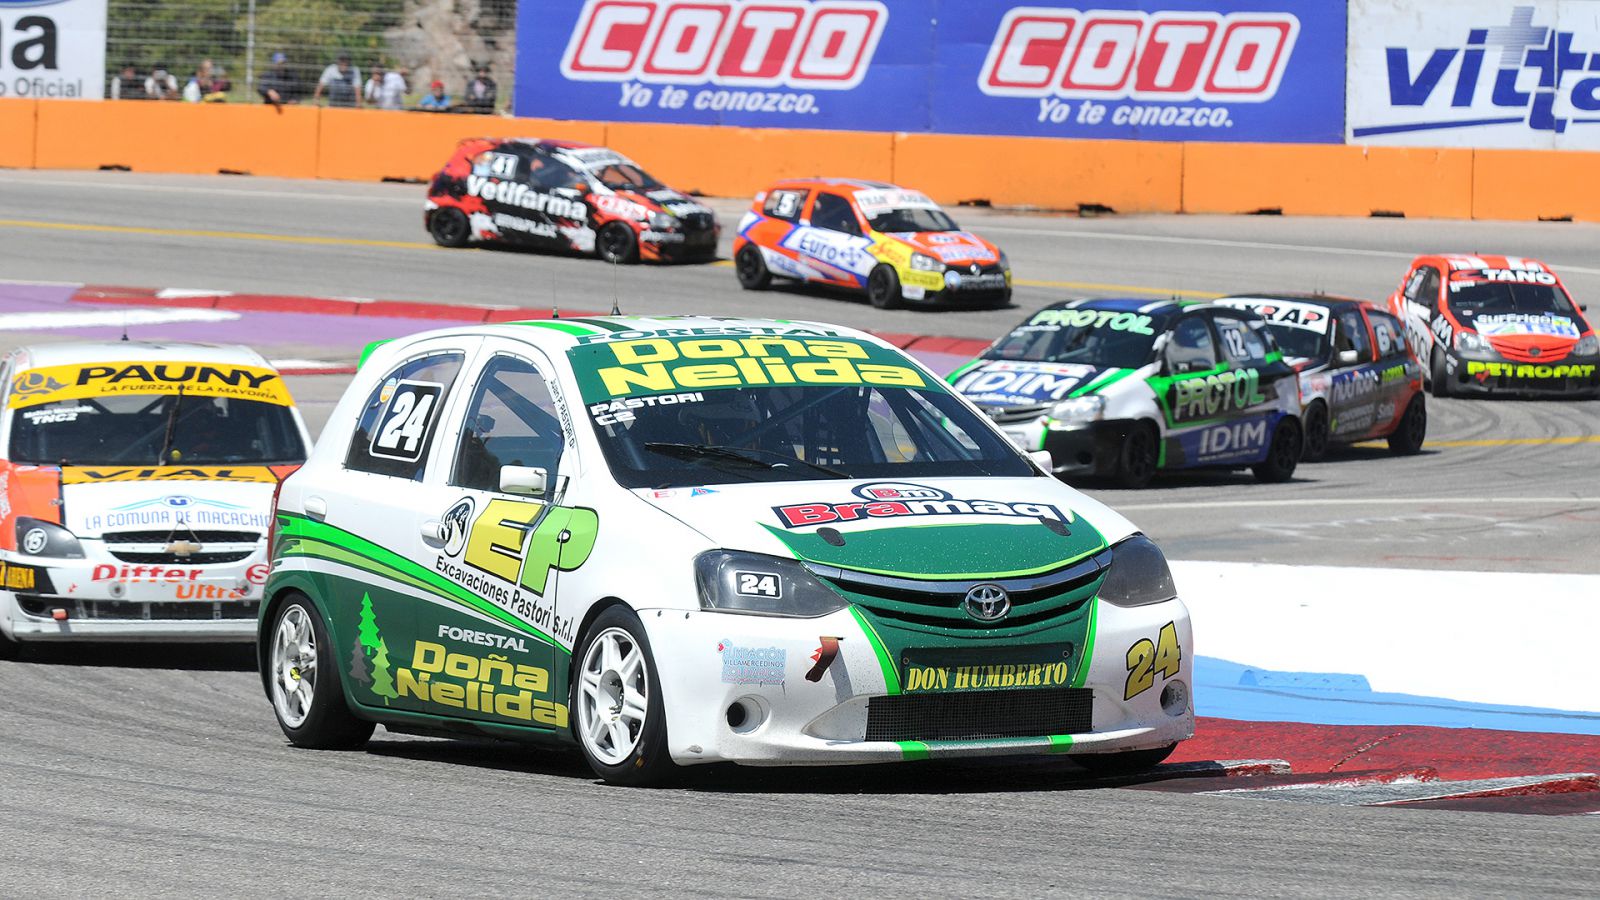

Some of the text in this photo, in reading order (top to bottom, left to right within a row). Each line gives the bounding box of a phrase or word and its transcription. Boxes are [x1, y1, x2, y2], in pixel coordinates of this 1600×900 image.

[570, 1, 879, 82] COTO
[987, 14, 1294, 94] COTO
[15, 77, 82, 97] Oficial
[618, 82, 819, 114] Yo te conozco.
[1038, 99, 1234, 128] Yo te conozco.
[492, 155, 516, 175] 41
[467, 174, 587, 220] Vetifarma
[800, 237, 837, 260] Euro
[1482, 269, 1556, 284] TANO
[577, 327, 854, 345] FORESTAL
[608, 335, 870, 365] Doña
[1224, 328, 1247, 357] 12
[1376, 325, 1391, 352] 6
[75, 365, 278, 389] PAUNY
[598, 357, 927, 396] Nelida
[1467, 361, 1596, 378] PETROPAT
[953, 370, 1080, 400] IDIM
[1174, 367, 1265, 419] PROTOL
[590, 392, 704, 416] PASTORI
[595, 410, 637, 426] C2
[378, 391, 434, 452] 24
[560, 404, 574, 439] PASTORI
[1199, 420, 1267, 455] IDIM
[83, 470, 256, 478] VIAL
[870, 488, 940, 499] Bm
[85, 516, 101, 530] LA
[107, 511, 170, 527] COMUNA
[176, 511, 191, 523] DE
[775, 500, 1068, 527] Bramaq
[464, 498, 598, 598] EP
[91, 564, 204, 583] Differ
[741, 574, 777, 595] 24
[176, 583, 246, 599] Ultra
[436, 555, 574, 643] Excavaciones Pastori s.r.l.
[438, 624, 529, 653] FORESTAL
[412, 640, 549, 692] Doña
[1124, 620, 1181, 701] 24
[906, 662, 1068, 691] DON HUMBERTO
[397, 667, 569, 728] Nelida
